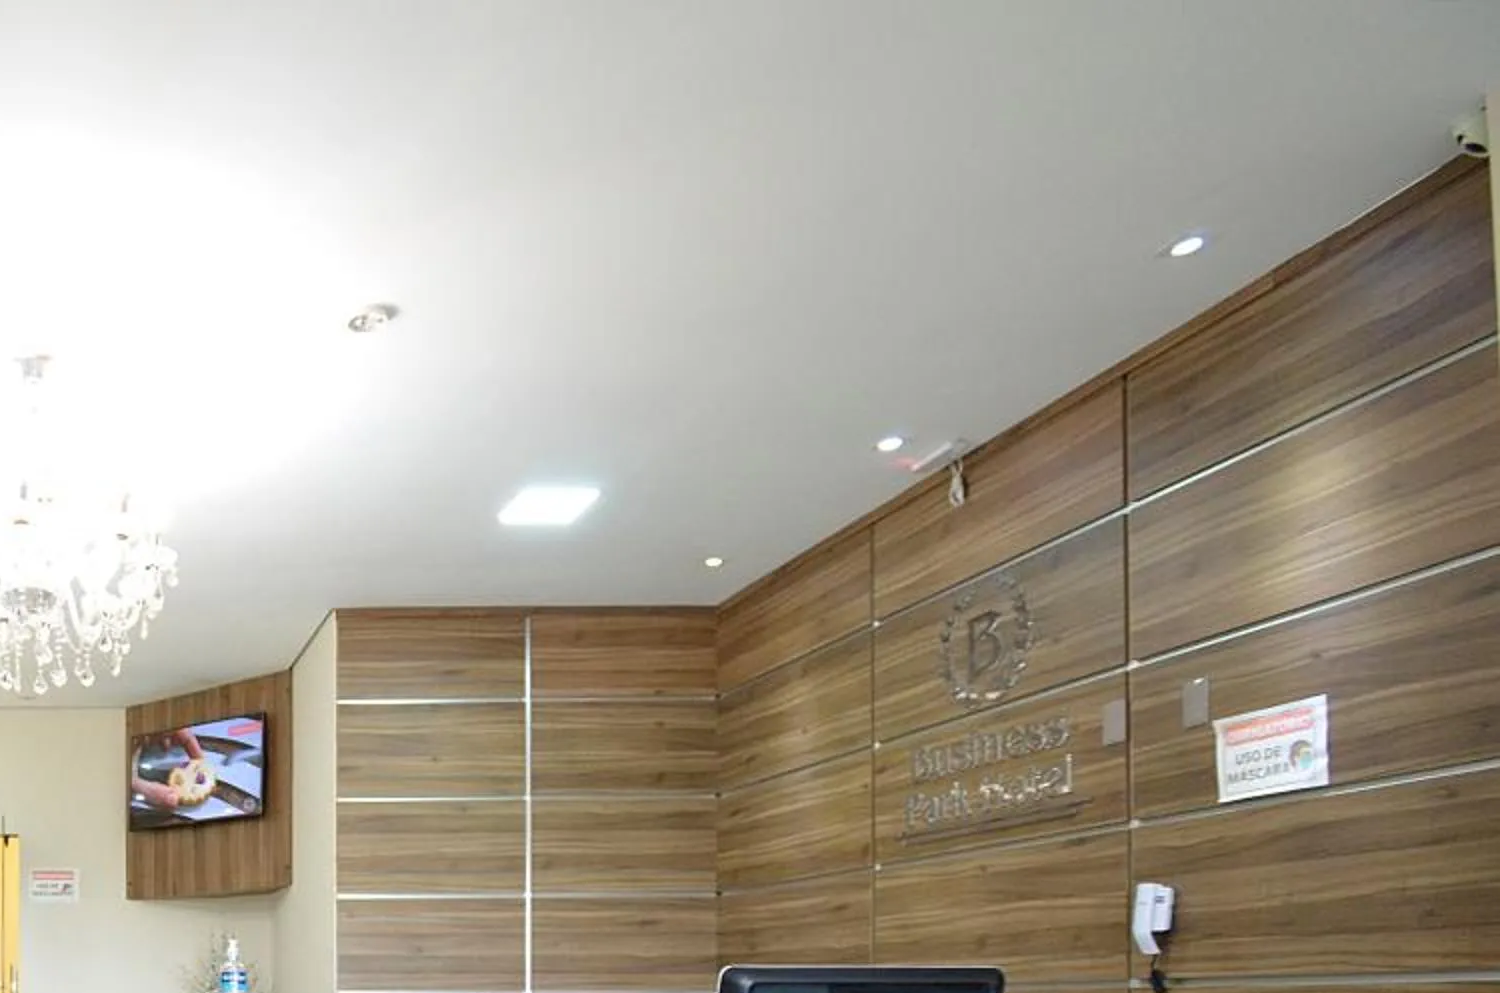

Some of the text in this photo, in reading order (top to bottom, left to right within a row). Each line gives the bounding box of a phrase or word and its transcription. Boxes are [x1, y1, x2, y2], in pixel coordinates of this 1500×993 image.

[966, 609, 1002, 684] B
[912, 717, 1071, 785] Business
[1235, 745, 1282, 765] USO DE
[903, 782, 970, 832] Park
